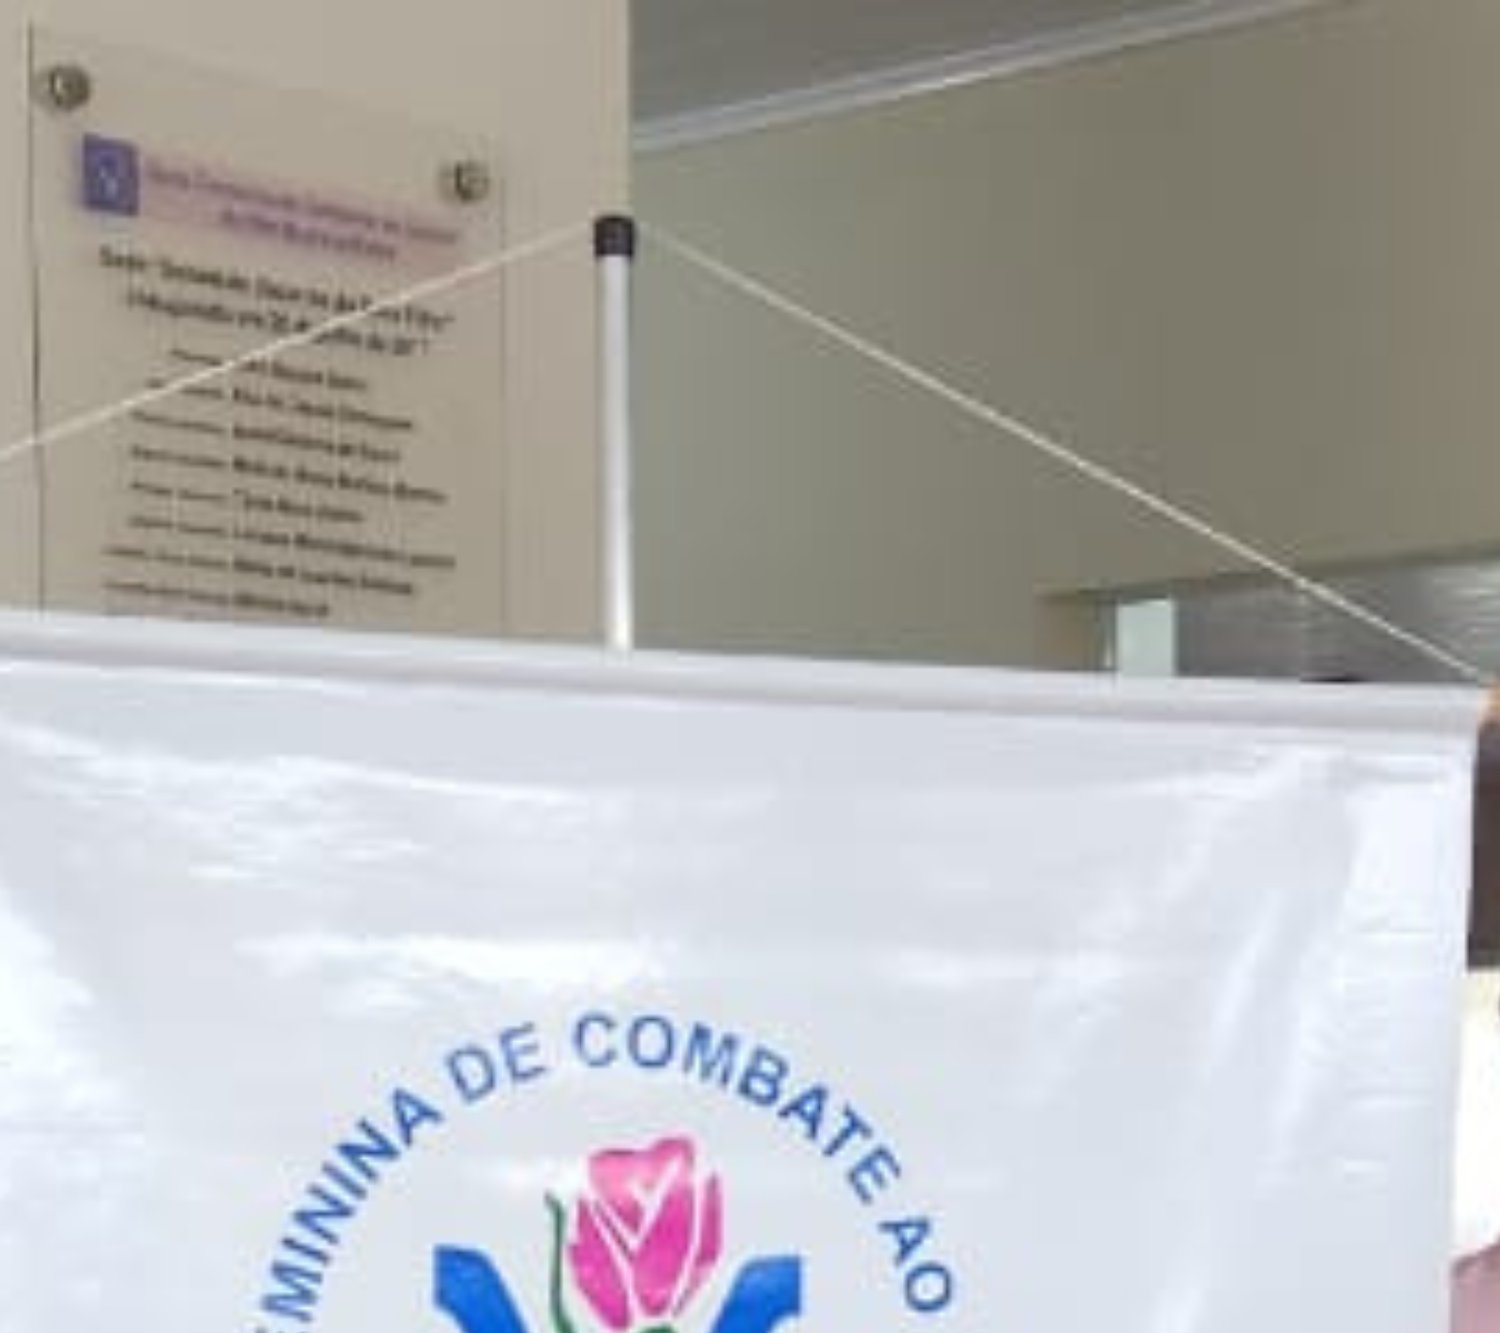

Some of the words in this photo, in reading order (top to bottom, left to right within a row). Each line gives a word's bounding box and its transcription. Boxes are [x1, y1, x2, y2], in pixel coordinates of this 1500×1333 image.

[445, 1021, 546, 1103] DE
[573, 1012, 902, 1205] COMBATE
[880, 1214, 953, 1314] AO
